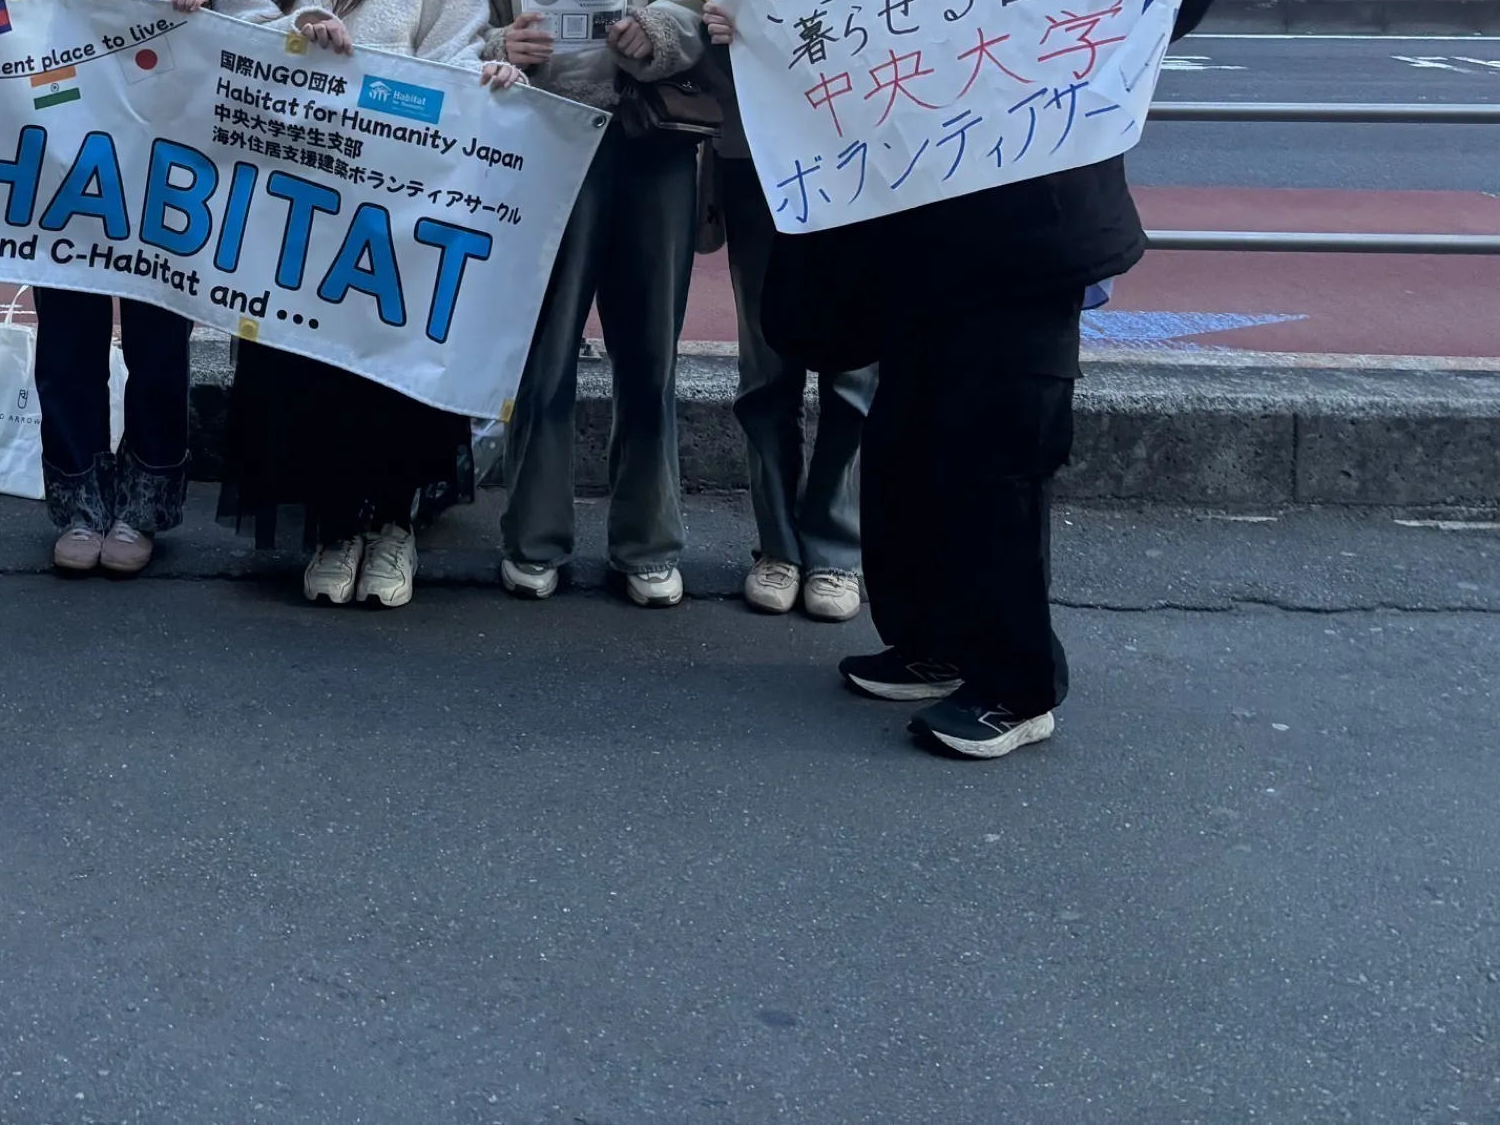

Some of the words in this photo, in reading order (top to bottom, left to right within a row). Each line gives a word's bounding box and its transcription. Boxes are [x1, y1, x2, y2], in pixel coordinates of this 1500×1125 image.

[41, 42, 97, 73] place
[102, 33, 125, 50] to
[129, 17, 174, 43] live.
[220, 50, 348, 97] 国際NGO団体
[214, 103, 364, 159] 中央大学学生支部
[216, 77, 298, 117] Habitat
[303, 100, 337, 124] for
[341, 108, 457, 155] Humanity
[462, 137, 524, 172] Japan
[776, 81, 1136, 223] ボランティアサー
[51, 238, 201, 297] C-Habitat
[8, 415, 42, 426] ARROW
